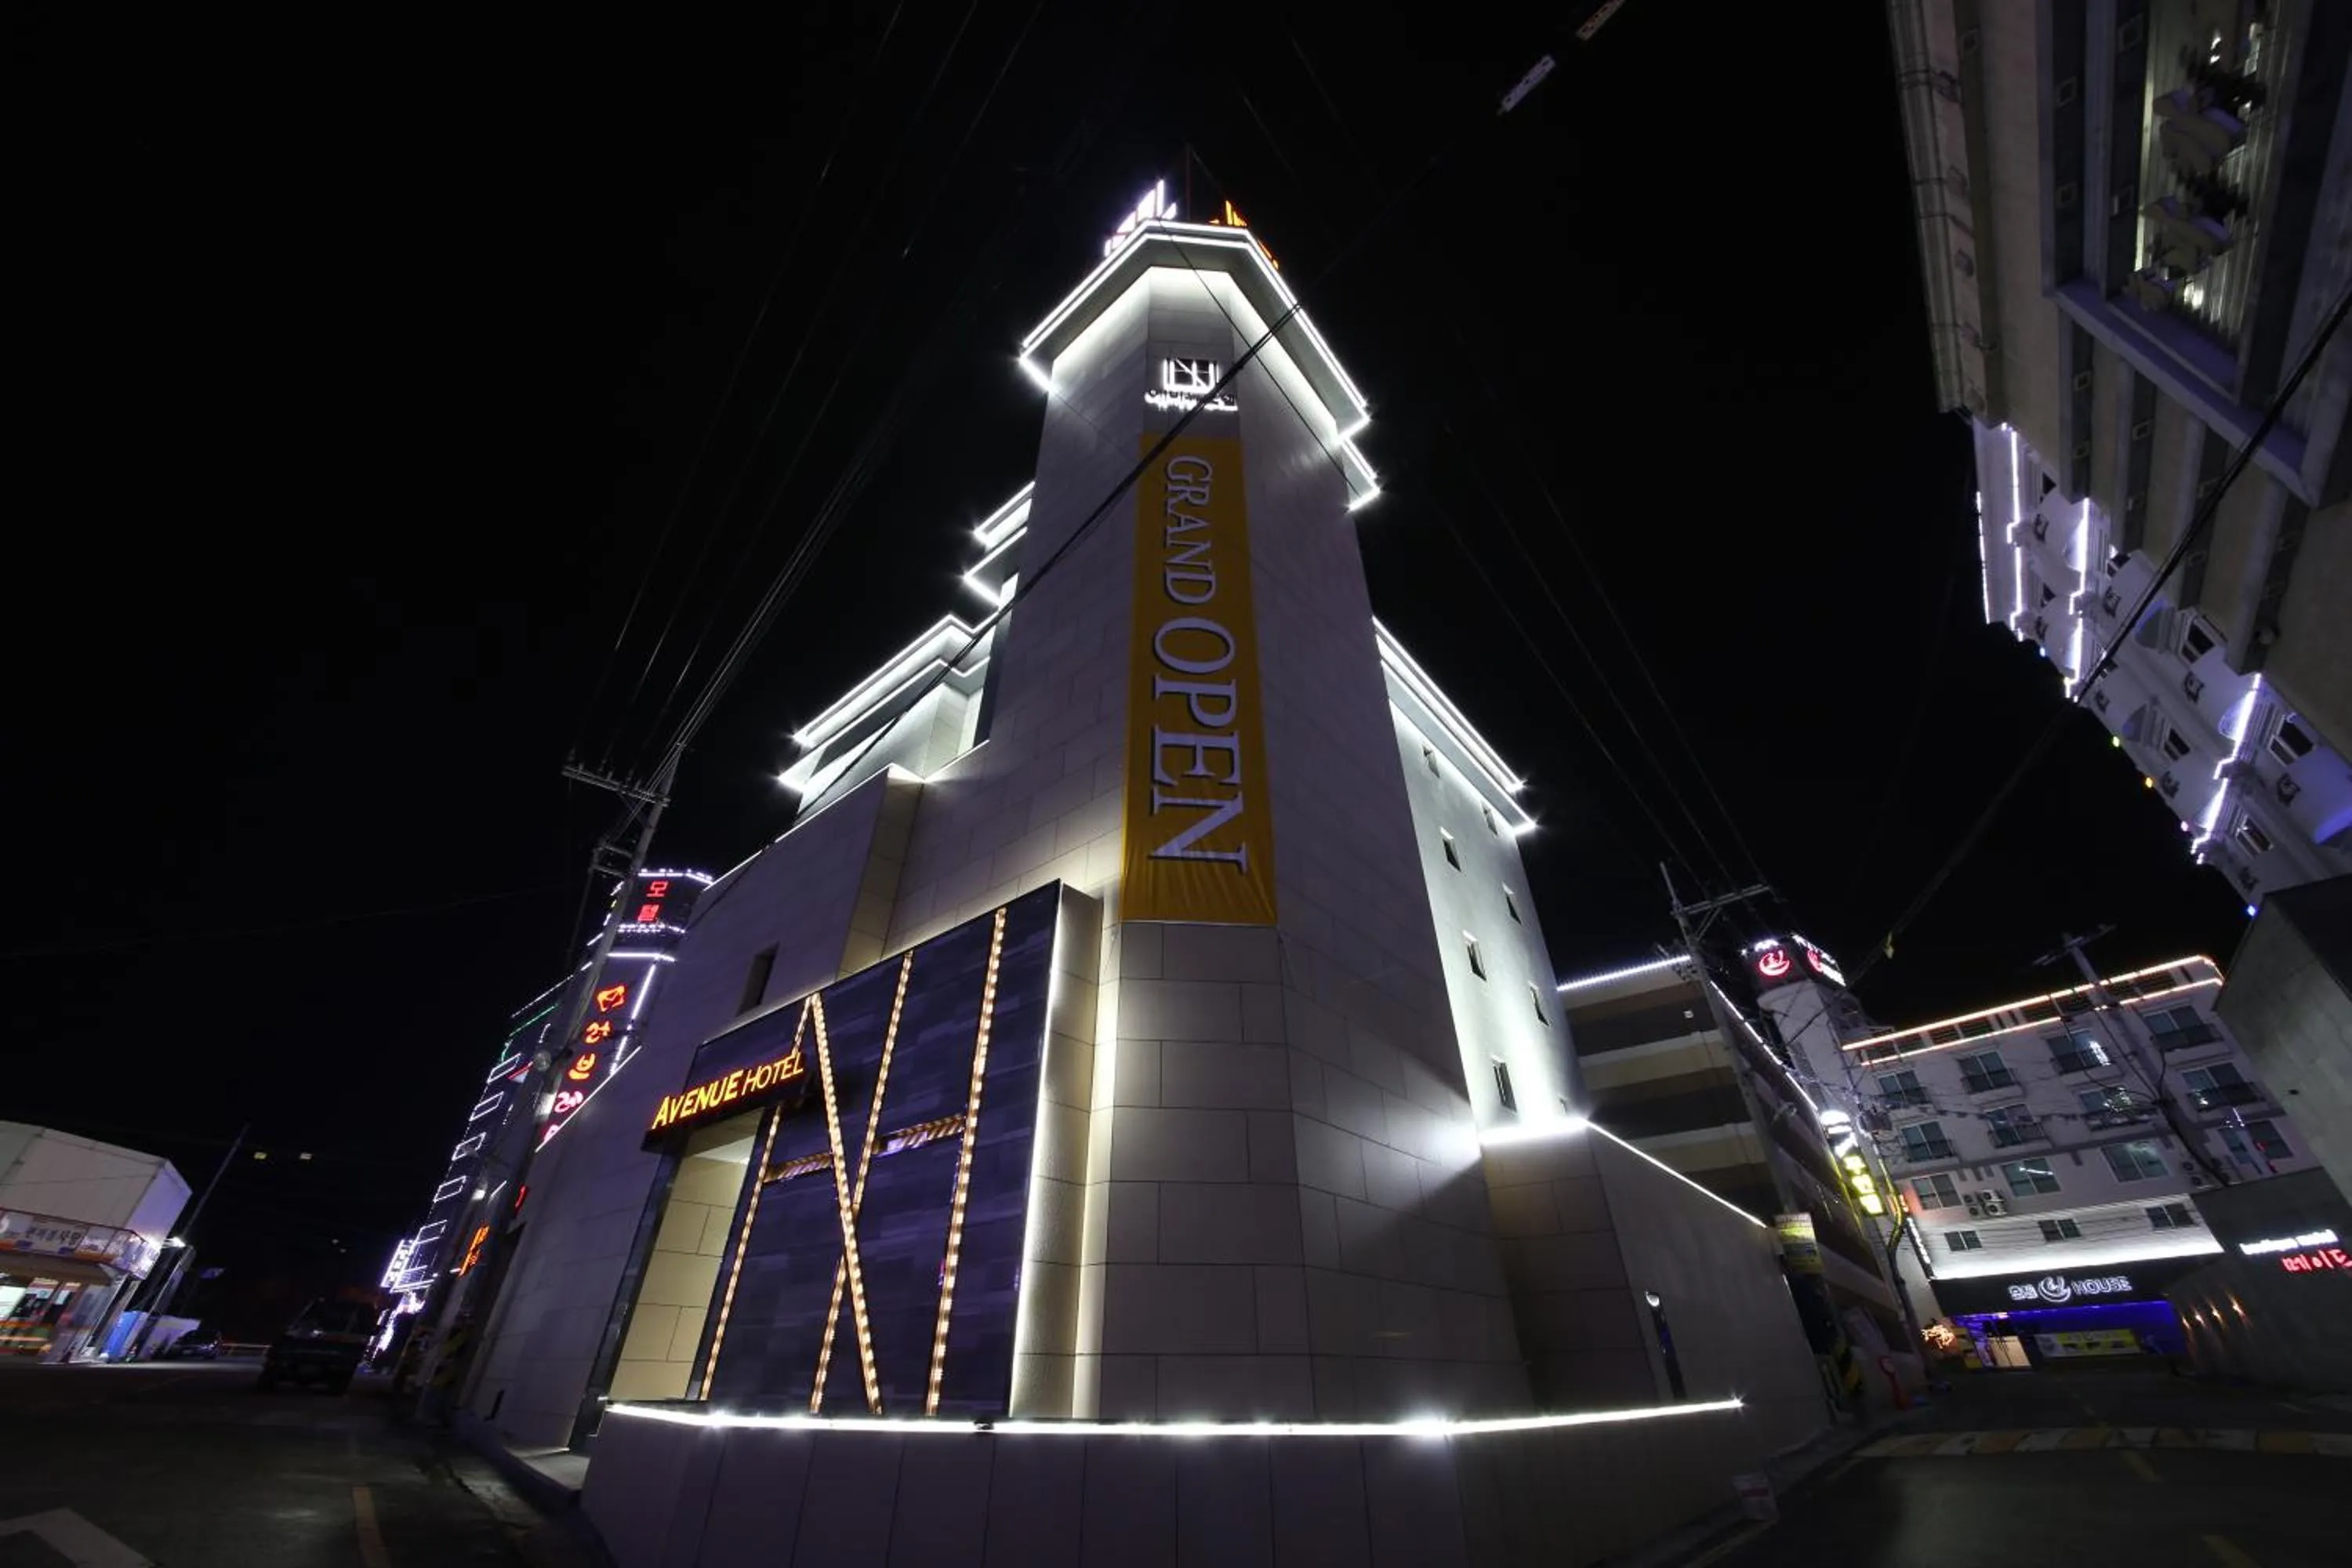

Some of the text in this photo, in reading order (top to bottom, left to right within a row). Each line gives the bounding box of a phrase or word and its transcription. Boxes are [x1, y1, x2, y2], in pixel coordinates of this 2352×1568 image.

[1165, 455, 1216, 605] GRAND
[1149, 618, 1248, 875] OPEN
[652, 1051, 804, 1130] AVENUE HOTEL
[2071, 1275, 2132, 1295] HOUSE
